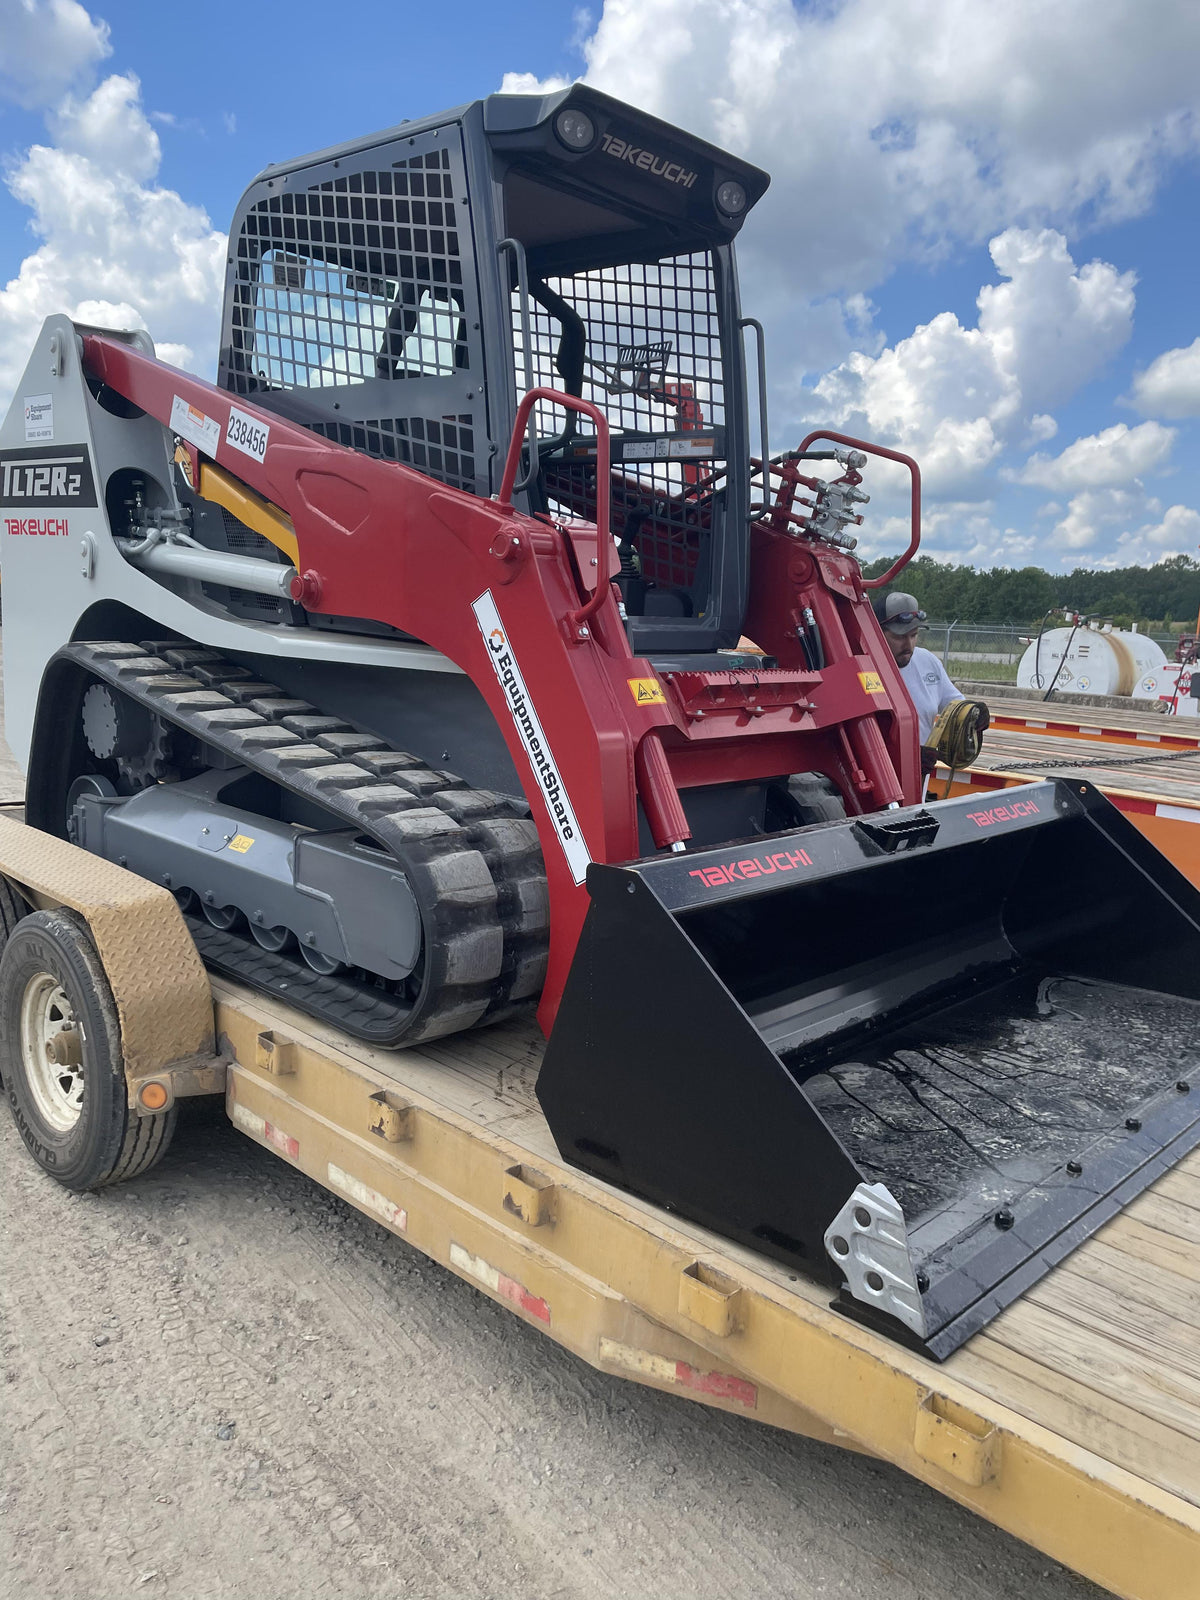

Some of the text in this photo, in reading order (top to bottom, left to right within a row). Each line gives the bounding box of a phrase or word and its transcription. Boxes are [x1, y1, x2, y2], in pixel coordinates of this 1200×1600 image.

[227, 415, 266, 456] 238456
[0, 456, 84, 498] TL12R2
[497, 651, 574, 843] EquipmentShare
